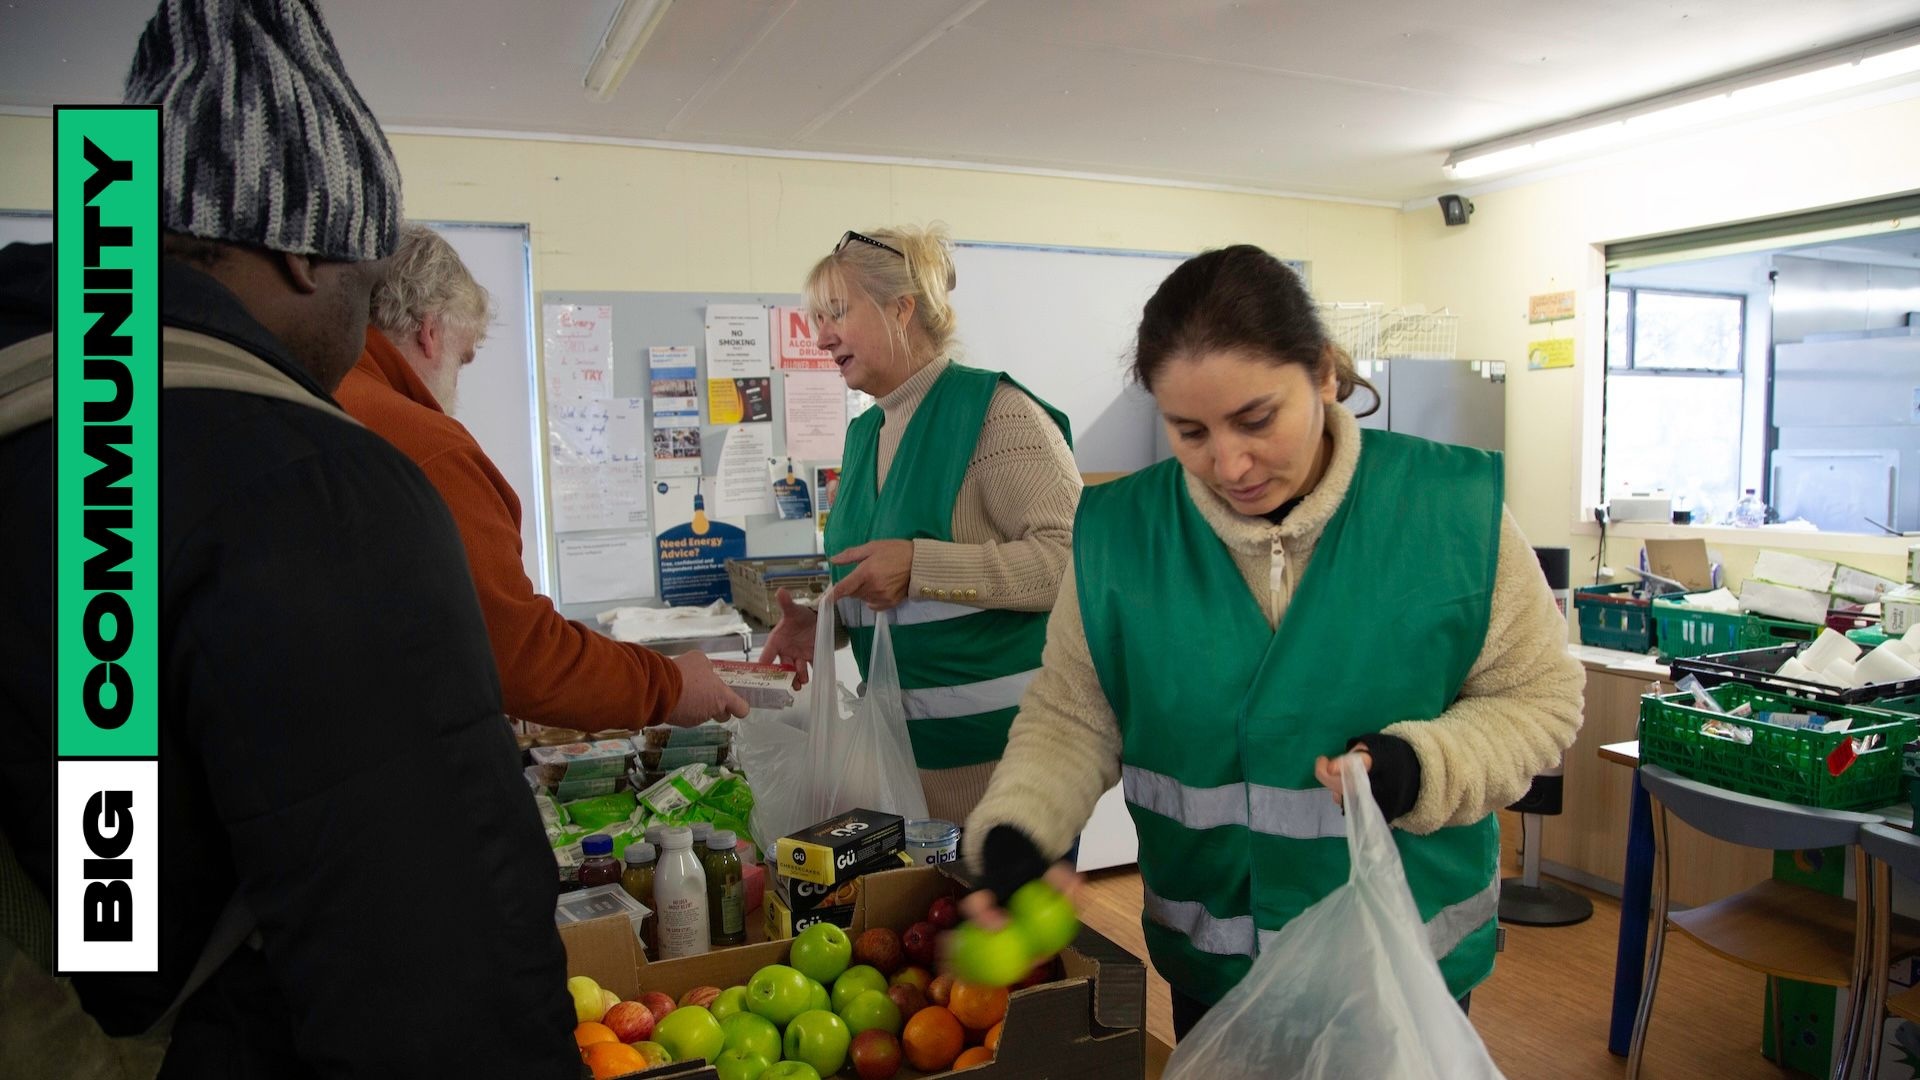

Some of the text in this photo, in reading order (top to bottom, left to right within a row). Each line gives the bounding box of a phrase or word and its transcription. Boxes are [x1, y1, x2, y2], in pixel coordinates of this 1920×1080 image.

[789, 312, 811, 339] N
[731, 330, 743, 338] NO
[789, 340, 817, 348] ALCO
[660, 537, 723, 548] Need Energy
[661, 548, 700, 559] Advice?
[926, 849, 956, 865] alpro
